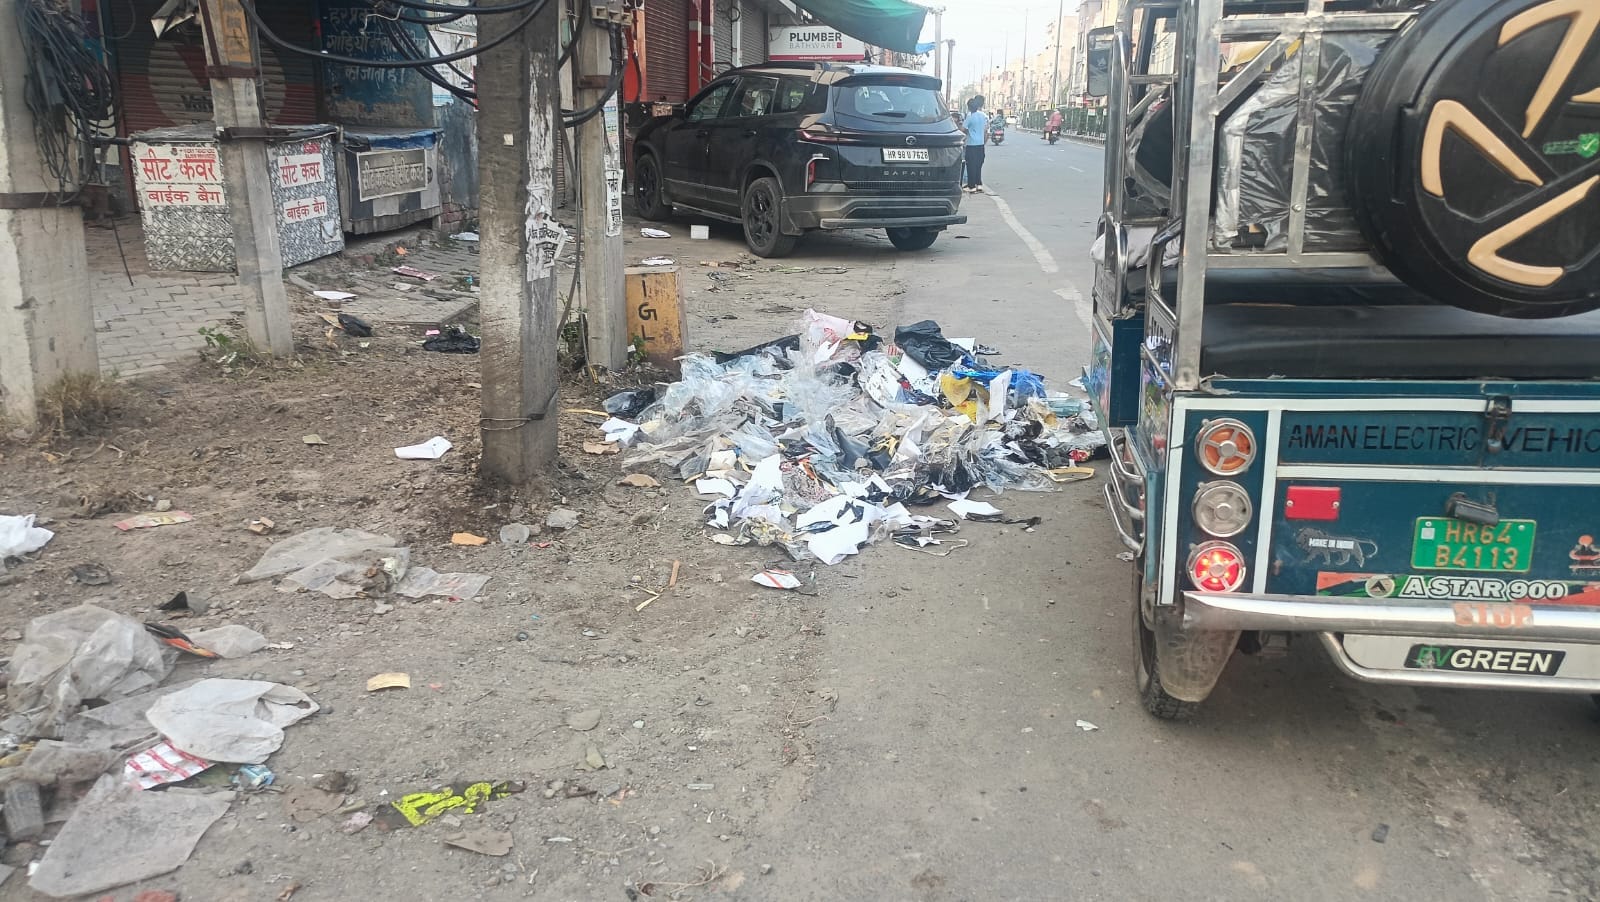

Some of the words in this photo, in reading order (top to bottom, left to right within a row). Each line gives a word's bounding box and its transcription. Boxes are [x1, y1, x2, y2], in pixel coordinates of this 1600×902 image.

[789, 32, 843, 42] PLUMBER
[140, 147, 172, 181] सीट
[176, 159, 217, 181] कवर
[280, 156, 298, 184] सीट
[299, 162, 321, 182] कवर
[146, 185, 190, 204] बाईक
[196, 185, 221, 203] बैग
[286, 201, 310, 219] बाईक
[312, 198, 325, 214] बैग
[1288, 425, 1357, 449] AMAN
[1363, 425, 1479, 450] ELECTRIC
[1444, 521, 1513, 544] HR64
[1435, 544, 1518, 569] B4113
[1402, 577, 1426, 597] A
[1429, 577, 1504, 600] STAR
[1508, 580, 1566, 600] 900
[1454, 604, 1532, 629] STOP
